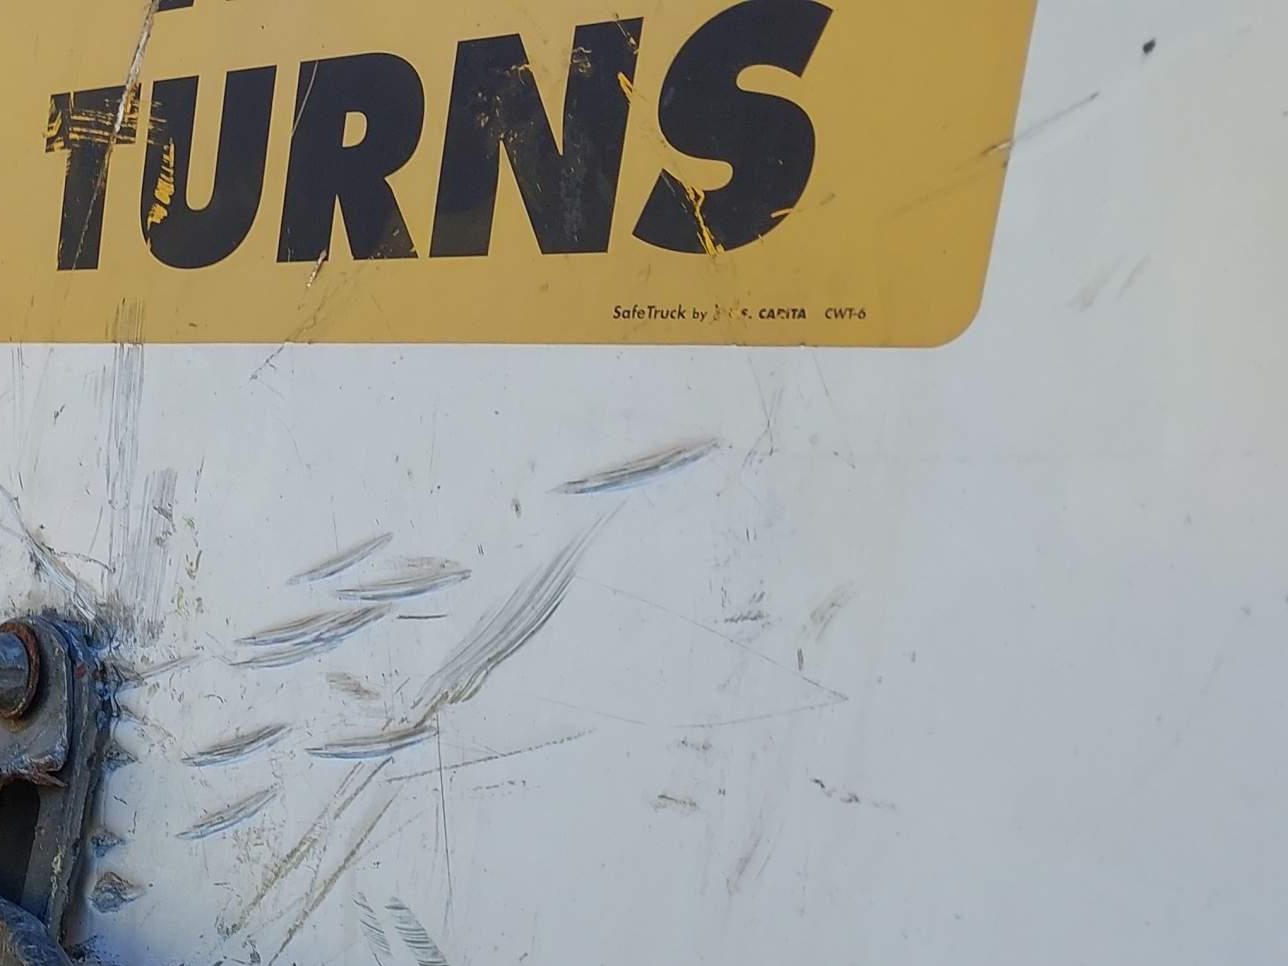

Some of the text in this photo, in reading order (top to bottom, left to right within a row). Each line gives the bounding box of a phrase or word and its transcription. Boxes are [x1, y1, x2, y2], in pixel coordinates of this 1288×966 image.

[45, 0, 832, 272] TURNS
[692, 306, 708, 322] by
[824, 307, 867, 320] CWT-6
